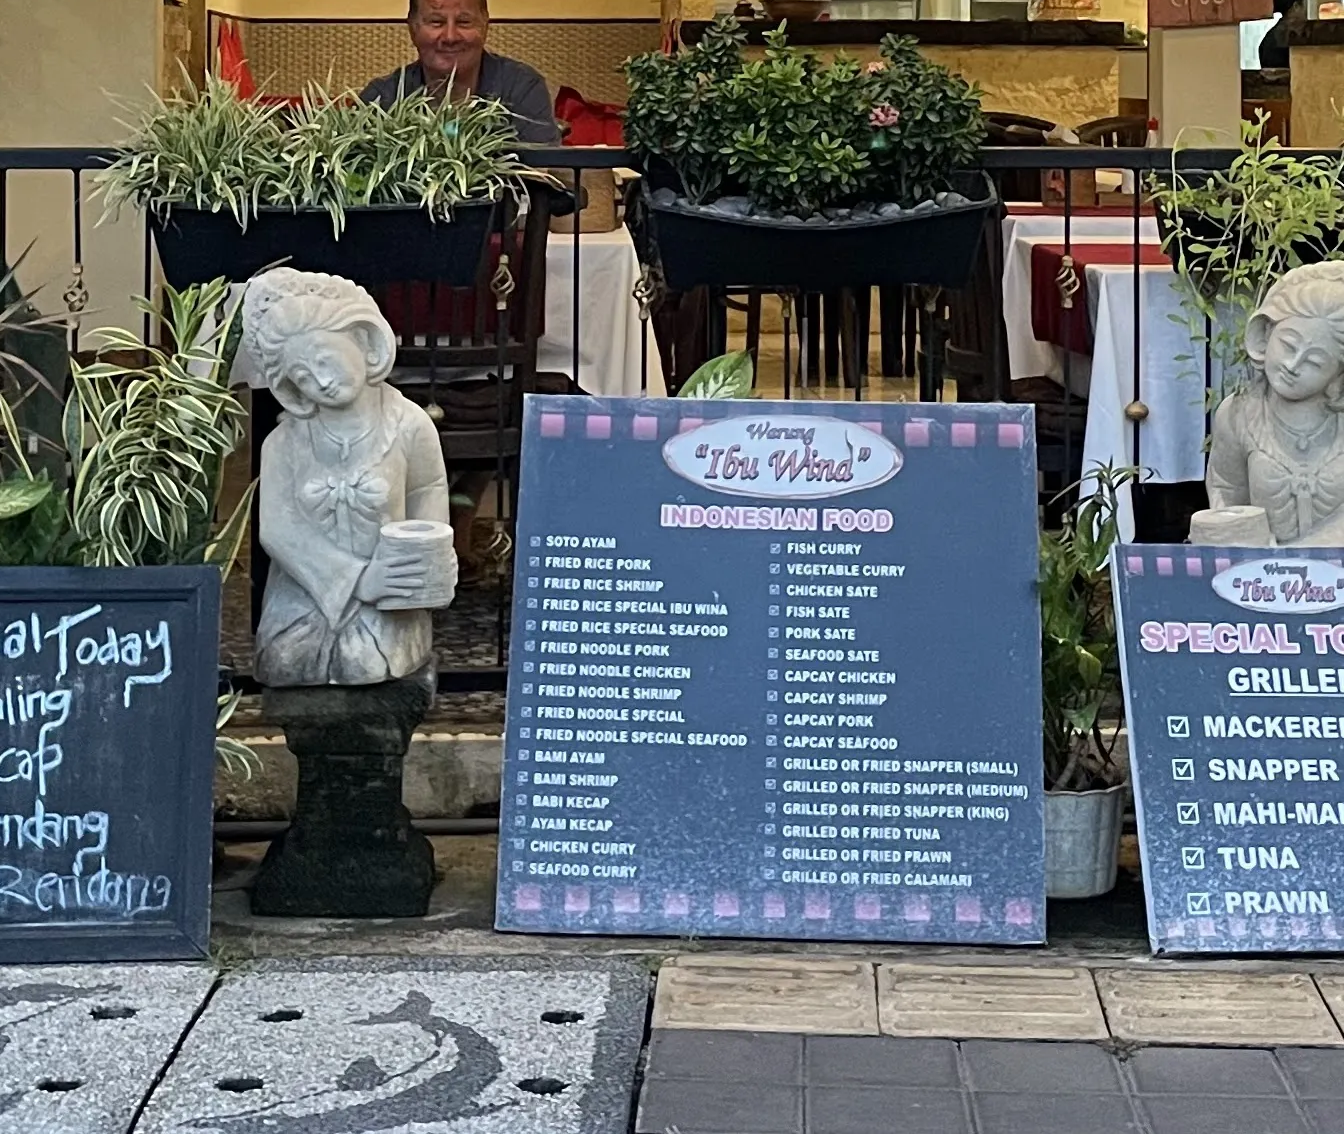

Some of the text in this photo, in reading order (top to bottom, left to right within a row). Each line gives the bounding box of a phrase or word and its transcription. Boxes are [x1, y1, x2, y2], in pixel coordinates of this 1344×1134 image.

[660, 503, 894, 534] INDONESIAN FOOD
[546, 535, 616, 549] SOTO AYAM
[787, 542, 862, 556] FISH CURRY
[545, 556, 651, 571] FRIED RICE PORK
[786, 563, 905, 577] VEGETABLE CURRY
[544, 577, 664, 592] FRIED RICE SHRIMP
[786, 584, 878, 598] CHICKEN SATE
[542, 598, 728, 615] FRIED RICE SPECIAL IBU WINA
[786, 605, 850, 619] FISH SATE
[541, 620, 728, 637] FRIED RICE SPECIAL SEAFOOD
[785, 626, 856, 641] PORK SATE
[1140, 621, 1301, 655] SPECIAL
[44, 604, 172, 707] Today
[540, 641, 670, 657] FRIED NOODLE PORK
[785, 648, 880, 662] SEAFOOD SATE
[539, 662, 691, 679] FRIED NOODLE CHICKEN
[784, 670, 896, 685] CAPCAY CHICKEN
[538, 684, 682, 700] FRIED NOODLE SHRIMP
[784, 691, 887, 706] CAPCAY SHRIMP
[537, 706, 685, 723] FRIED NOODLE SPECIAL
[784, 713, 873, 727] CAPCAY PORK
[536, 728, 748, 747] FRIED NOODLE SPECIAL SEAFOOD
[783, 735, 898, 751] CAPCAY SEAFOOD
[534, 750, 605, 765] BAMI AYAM
[783, 758, 1019, 776] GRILLED OR FRIED SNAPPER (SMALL)
[1208, 758, 1341, 782] SNAPPER
[533, 772, 619, 787] BAMI SHRIMP
[782, 780, 1029, 798] GRILLED OR FRIED SNAPPER (MEDIUM)
[532, 794, 610, 810] BABI KECAP
[782, 802, 1010, 821] GRILLED OR FRIED SNAPPER (KING)
[531, 817, 613, 832] AYAM KECAP
[782, 824, 941, 841] GRILLED OR FRIED TUNA
[530, 840, 636, 856] CHICKEN CURRY
[782, 847, 952, 864] GRILLED OR FRIED PRAWN
[1217, 846, 1301, 871] TUNA
[529, 862, 637, 879] SEAFOOD CURRY
[781, 870, 972, 888] GRILLED OR FRIED CALAMARI
[1224, 890, 1331, 915] PRAWN
